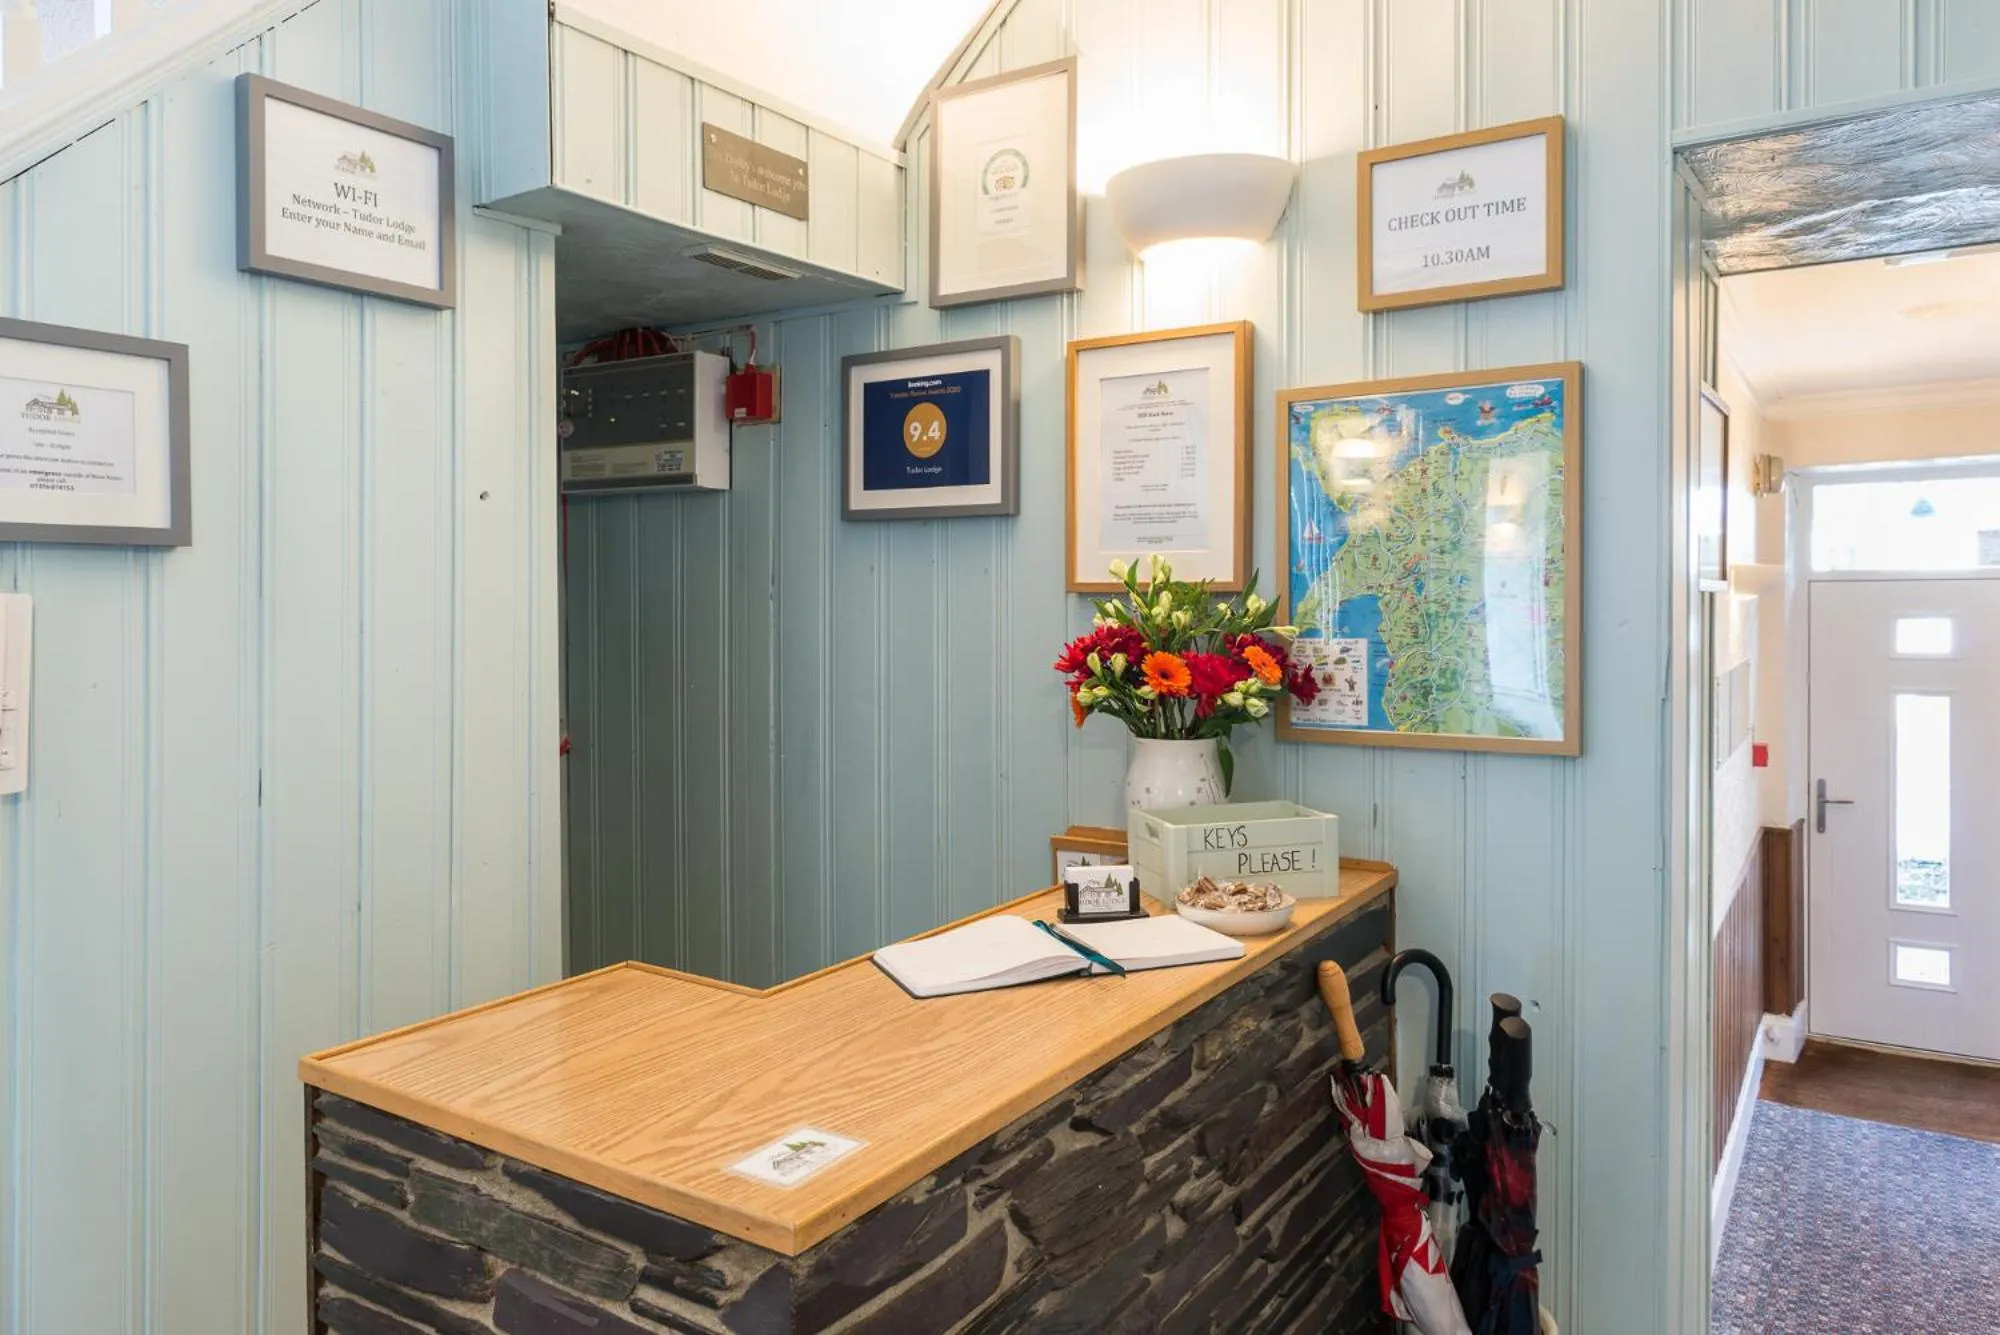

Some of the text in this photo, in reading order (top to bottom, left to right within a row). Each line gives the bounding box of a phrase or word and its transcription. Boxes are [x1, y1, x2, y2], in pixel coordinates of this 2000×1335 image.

[334, 182, 379, 208] WI-FI
[292, 193, 340, 215] Network
[352, 208, 384, 225] Tudor
[386, 216, 416, 234] Lodge
[1388, 196, 1527, 232] CHECK OUT TIME
[281, 207, 426, 251] Enter your Name and Email
[1422, 245, 1491, 268] 10.30AM
[909, 420, 941, 442] 9.4
[1203, 825, 1248, 850] KEYS
[1237, 850, 1302, 875] PLEASE
